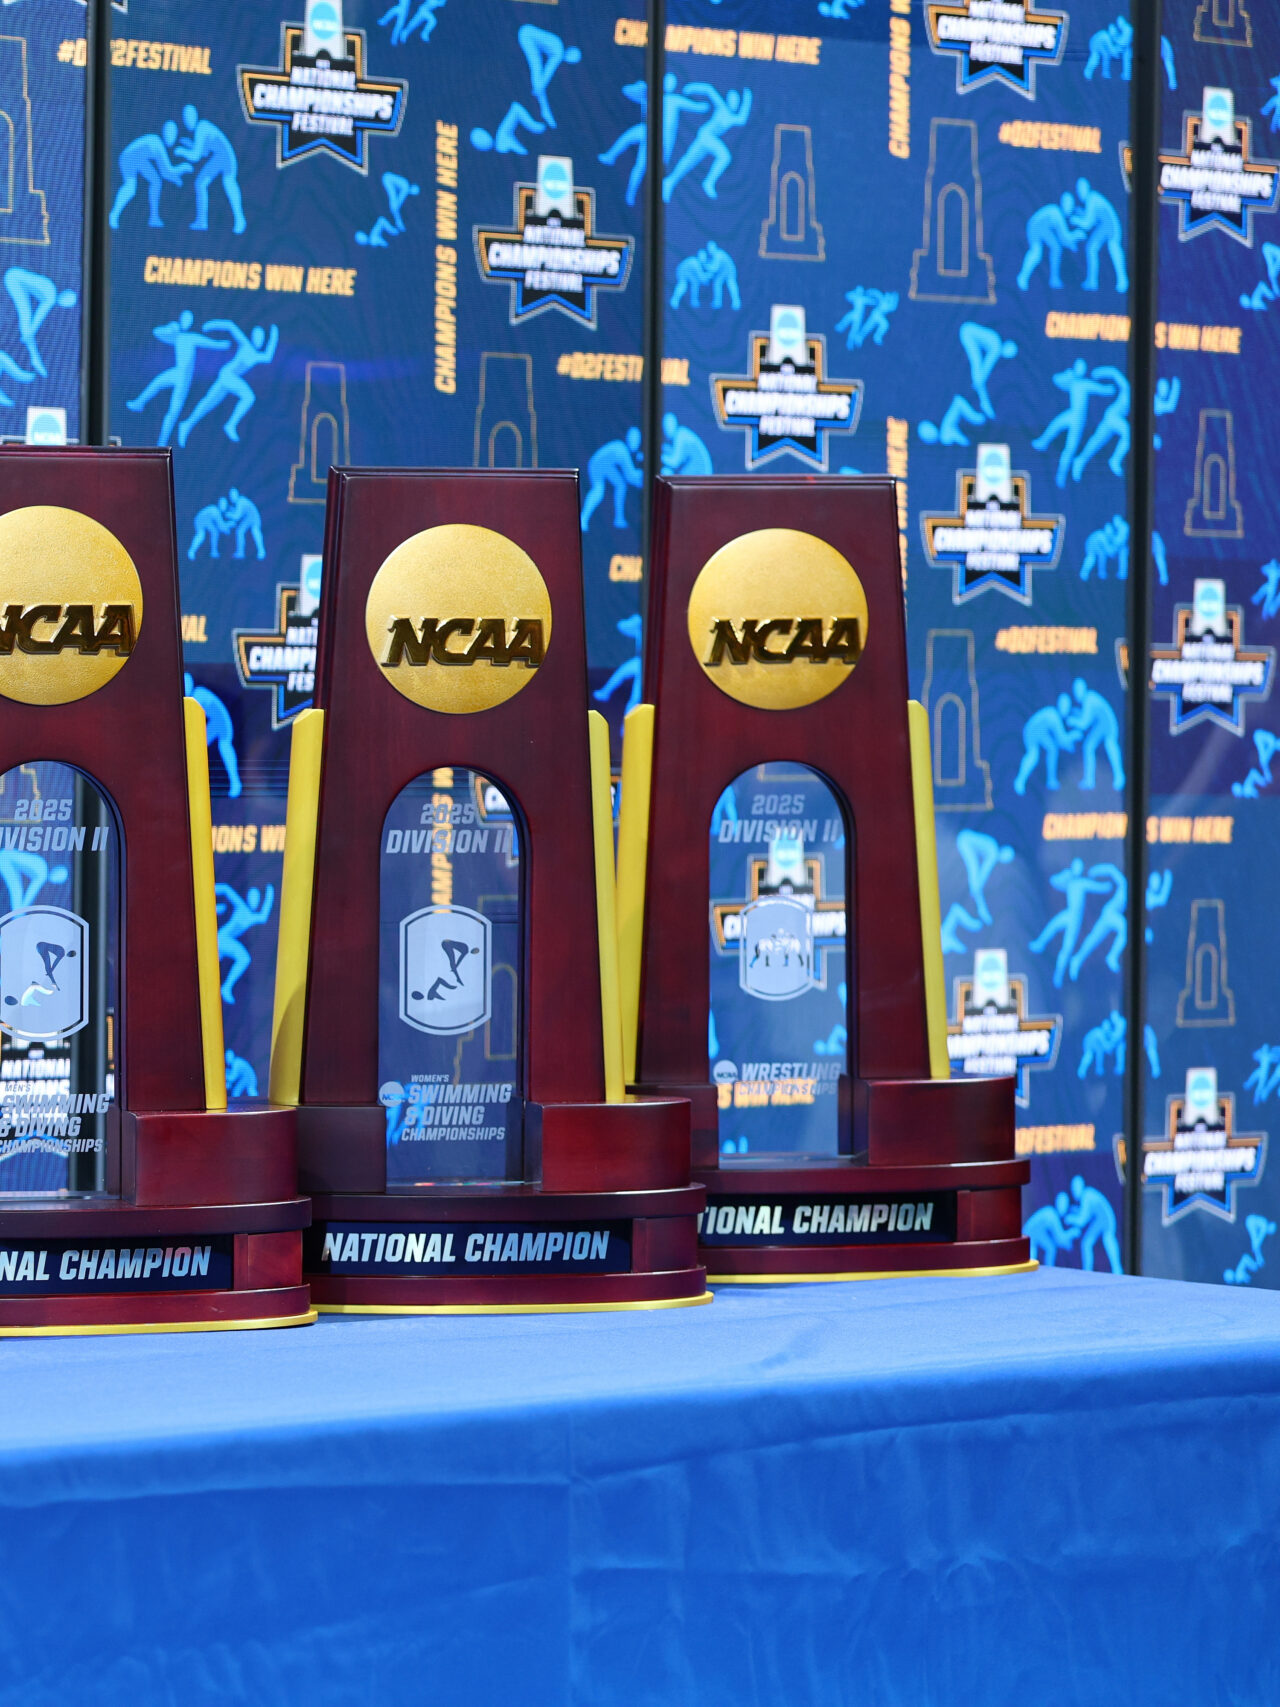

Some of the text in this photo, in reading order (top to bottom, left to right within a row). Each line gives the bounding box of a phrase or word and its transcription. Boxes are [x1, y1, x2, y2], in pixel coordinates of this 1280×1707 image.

[253, 83, 394, 121] CHAMPIONSHIPS
[435, 120, 458, 394] CHAMPIONS WIN HERE
[144, 256, 357, 297] CHAMPIONS WIN HERE
[381, 615, 548, 668] NCAA
[703, 616, 864, 667] NCAA
[14, 799, 73, 821] 2025
[420, 803, 477, 825] 2025
[751, 794, 805, 815] 2025
[91, 826, 109, 852] II
[385, 829, 489, 854] DIVISION
[719, 819, 840, 843] DIVISION II
[411, 1074, 449, 1083] WOMEN'S
[741, 1062, 842, 1081] WRESTLING
[4, 1083, 31, 1092] MEN'S
[408, 1083, 512, 1104] SWIMMING
[2, 1093, 111, 1114] SWIMMING
[14, 1116, 82, 1137] DIVING
[404, 1106, 485, 1126] & DIVING
[401, 1127, 506, 1142] CHAMPIONSHIPS
[697, 1202, 934, 1235] TIONAL CHAMPION
[321, 1230, 611, 1263] NATIONAL CHAMPION
[58, 1246, 212, 1281] CHAMPION
